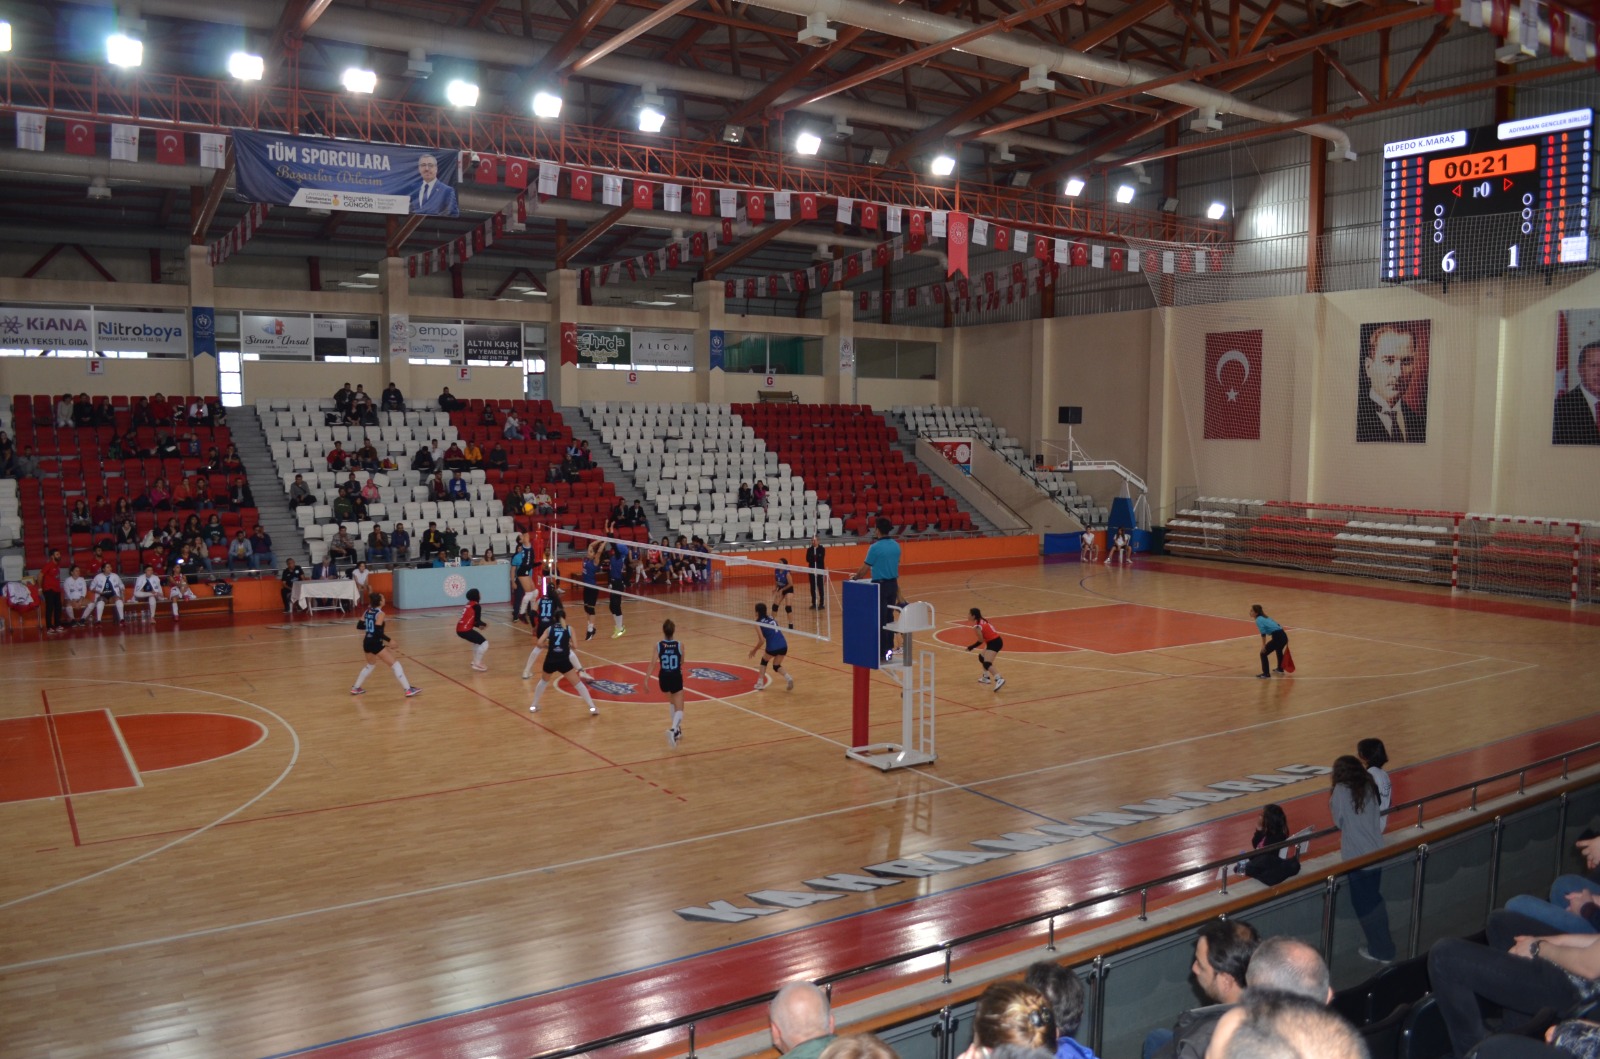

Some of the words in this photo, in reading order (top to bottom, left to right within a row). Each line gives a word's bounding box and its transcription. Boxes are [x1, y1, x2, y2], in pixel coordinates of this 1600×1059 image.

[1509, 124, 1539, 133] ADIYAMAN
[1386, 142, 1416, 152] ALPEDO
[1419, 135, 1455, 147] K.MARAŞ
[266, 142, 297, 162] TÜM
[302, 148, 391, 171] SPORCULARA
[1444, 154, 1508, 178] 00:21
[337, 171, 382, 185] Dilerim
[1442, 251, 1455, 272] 6
[1508, 244, 1518, 267] 1
[98, 322, 182, 342] Nitroboya
[419, 327, 457, 338] empo
[2, 336, 29, 345] KİMYA
[32, 337, 66, 345] TEKSTİL
[69, 338, 88, 346] GIDA
[245, 335, 273, 344] Sinan
[495, 341, 519, 349] KAŞIK
[91, 361, 99, 372] F
[461, 369, 467, 378] F
[629, 373, 637, 382] G
[766, 377, 773, 386] G
[541, 603, 552, 616] 11
[555, 632, 563, 645] 7
[661, 655, 678, 669] 20
